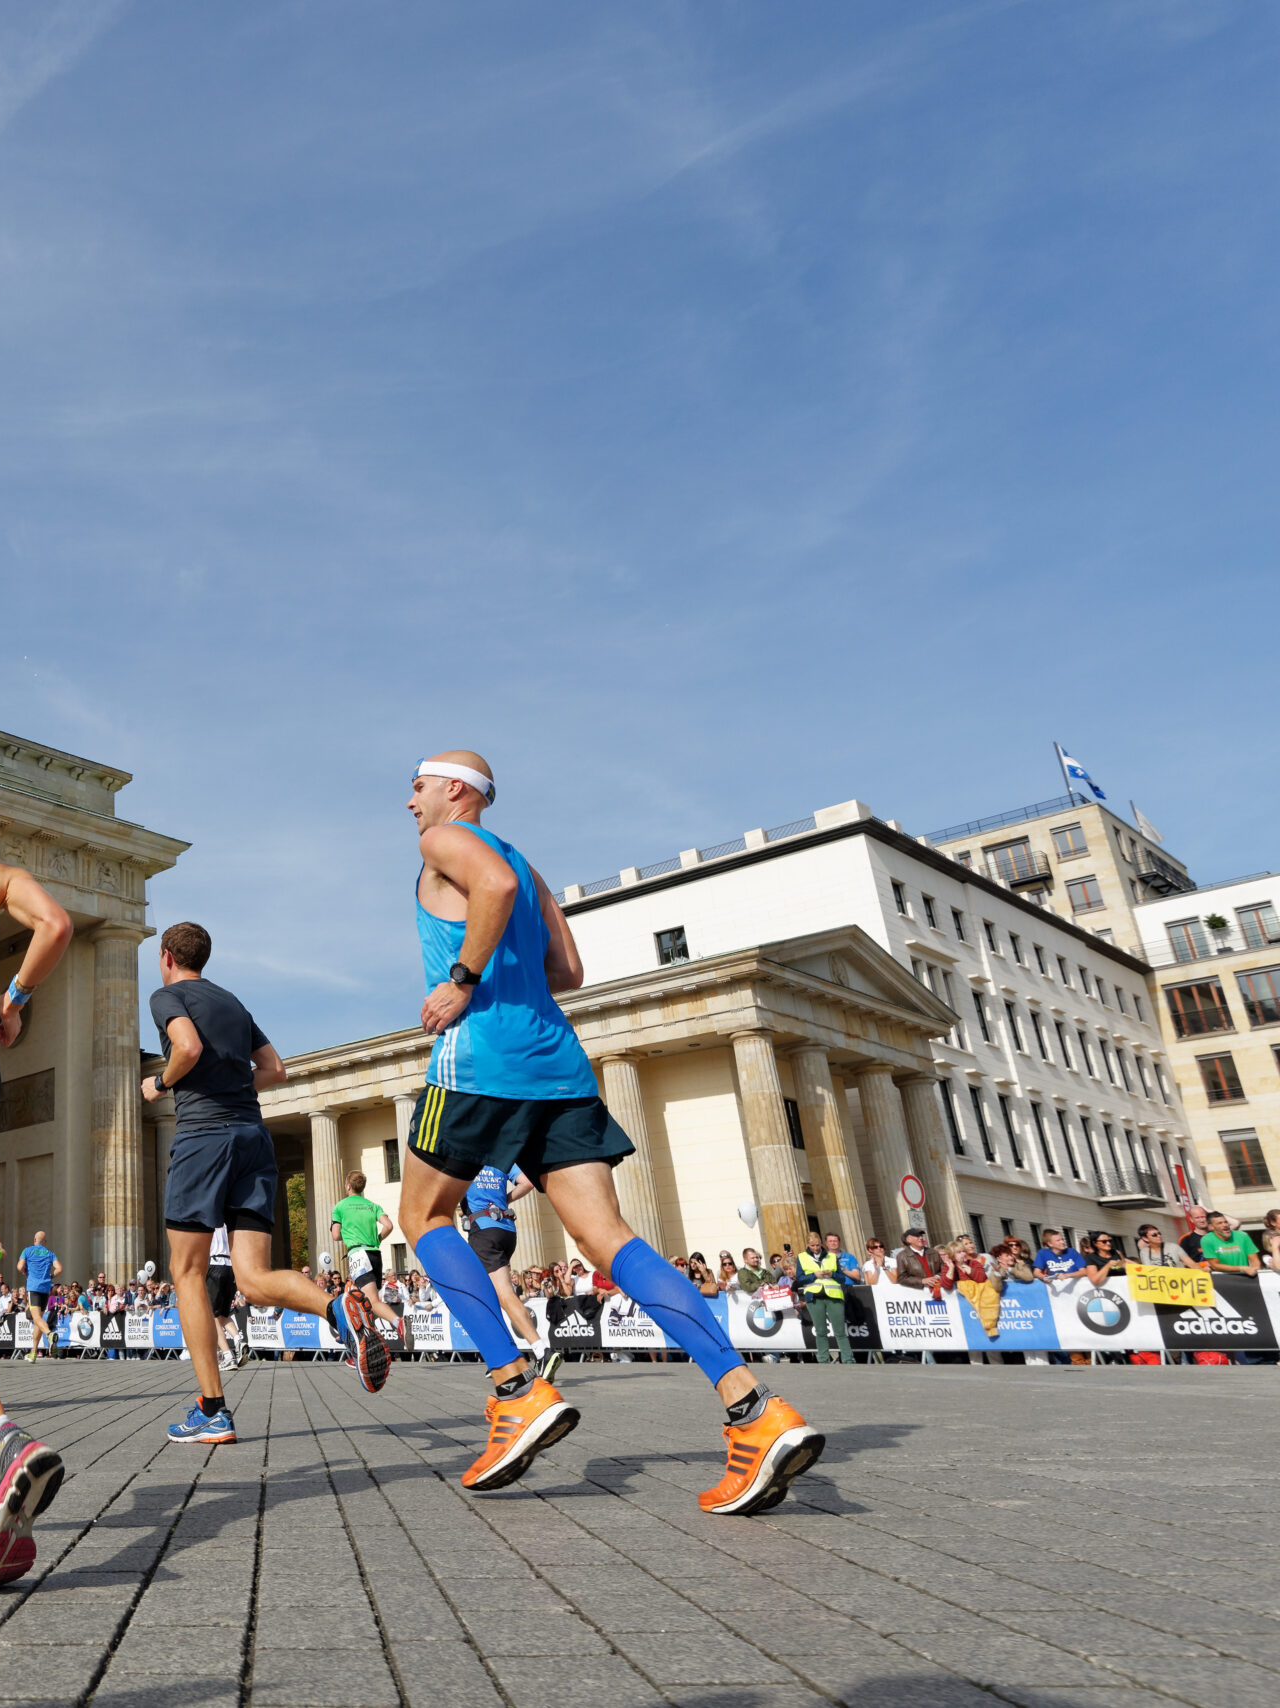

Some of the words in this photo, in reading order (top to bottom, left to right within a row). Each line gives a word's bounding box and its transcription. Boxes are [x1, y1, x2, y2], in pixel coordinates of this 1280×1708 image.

[885, 1300, 923, 1315] BMW
[128, 1318, 141, 1327] BMW
[251, 1316, 267, 1325] BMW
[888, 1316, 926, 1326] BERLIN
[996, 1320, 1034, 1330] RVICES
[554, 1324, 595, 1338] adidas
[1173, 1316, 1259, 1336] adidas
[102, 1331, 123, 1340] adidas
[414, 1333, 444, 1341] ARATHON
[608, 1328, 655, 1338] MARATHON
[889, 1327, 953, 1338] MARATHON
